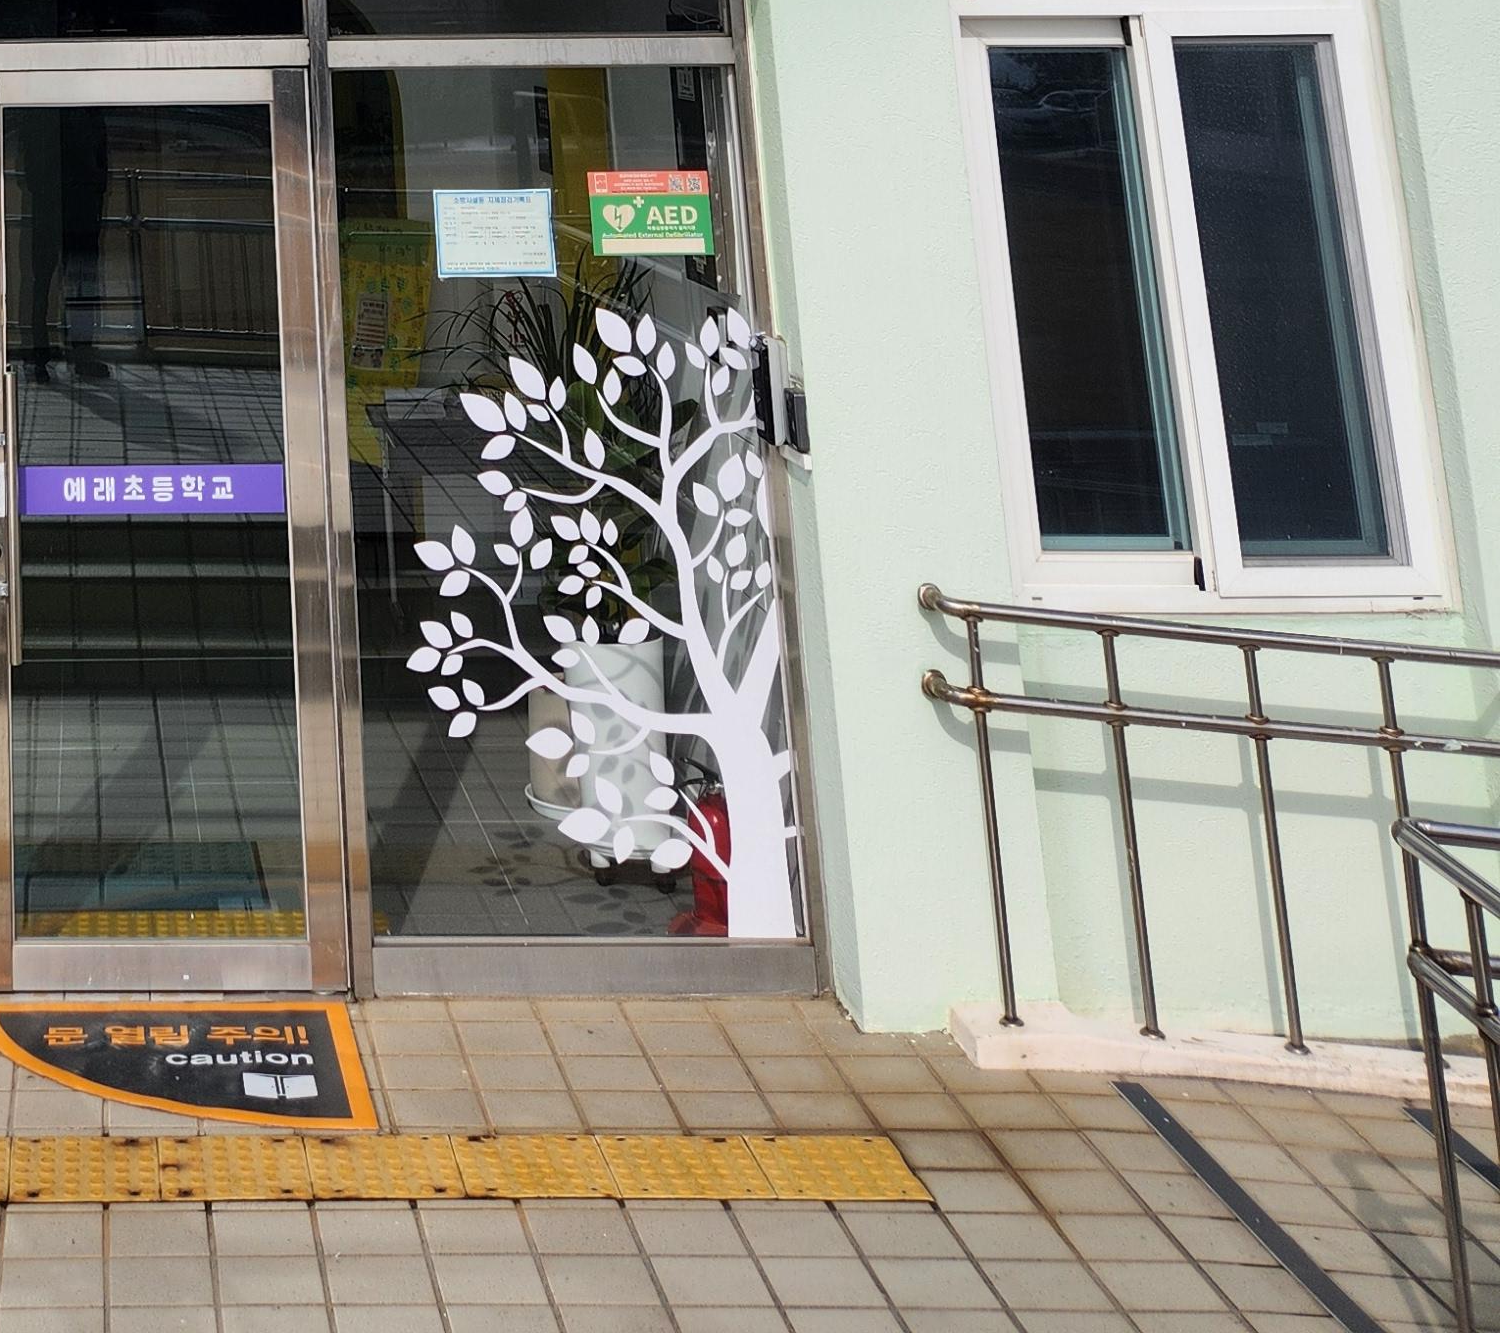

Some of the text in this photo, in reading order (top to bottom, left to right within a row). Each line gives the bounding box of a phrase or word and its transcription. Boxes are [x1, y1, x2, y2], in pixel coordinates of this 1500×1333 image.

[646, 205, 698, 225] AED
[44, 1024, 310, 1046] 문 열림 주의!
[164, 1050, 314, 1065] caution
